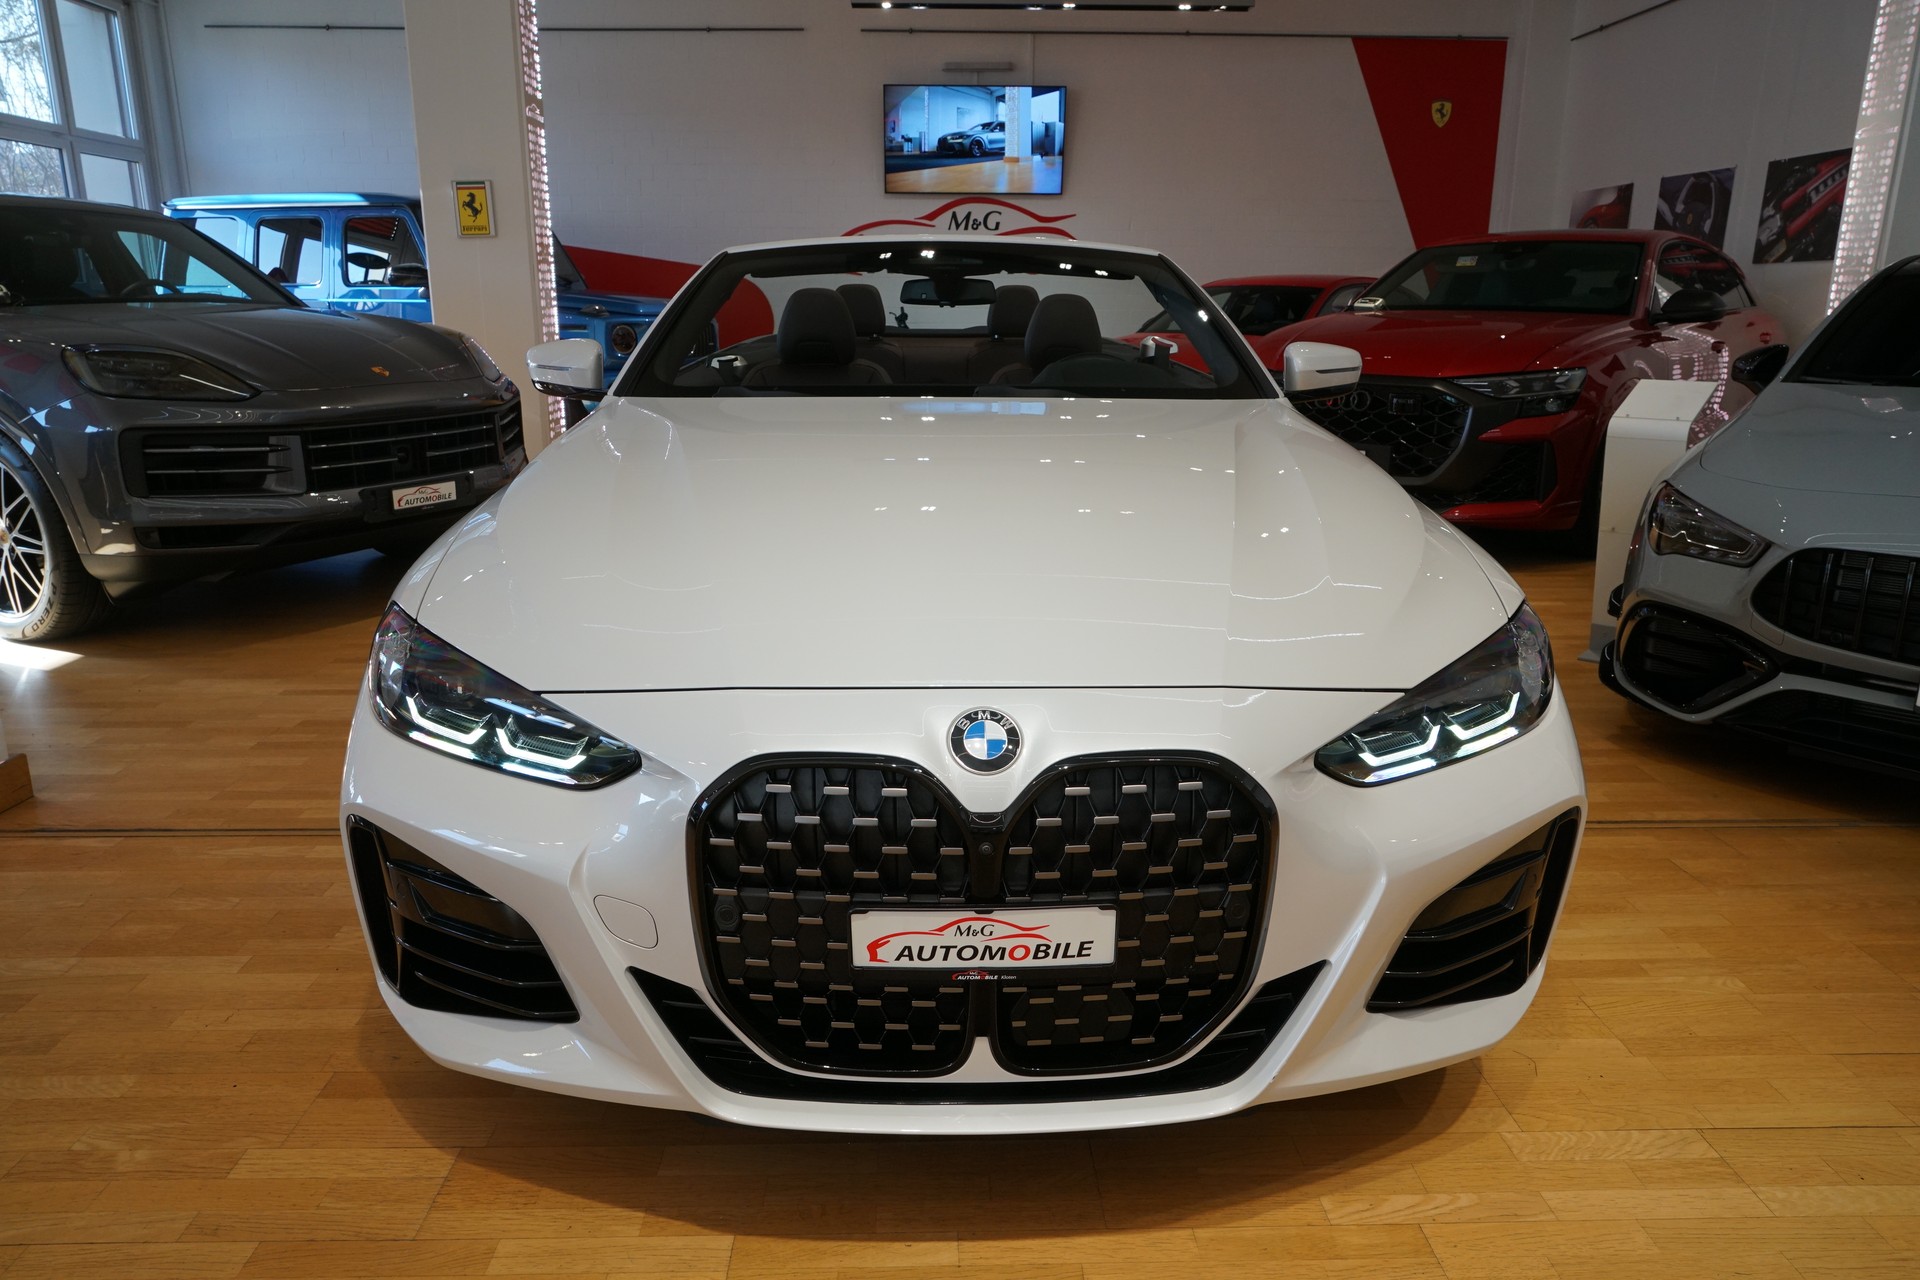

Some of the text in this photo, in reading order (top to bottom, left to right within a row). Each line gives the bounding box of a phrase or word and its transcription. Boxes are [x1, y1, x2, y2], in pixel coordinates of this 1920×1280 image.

[948, 210, 1002, 231] M&G
[404, 492, 453, 507] AUTOMOBILE
[956, 710, 1015, 731] BMW
[954, 924, 995, 937] M&G
[894, 940, 1095, 962] AUTOMOBILE
